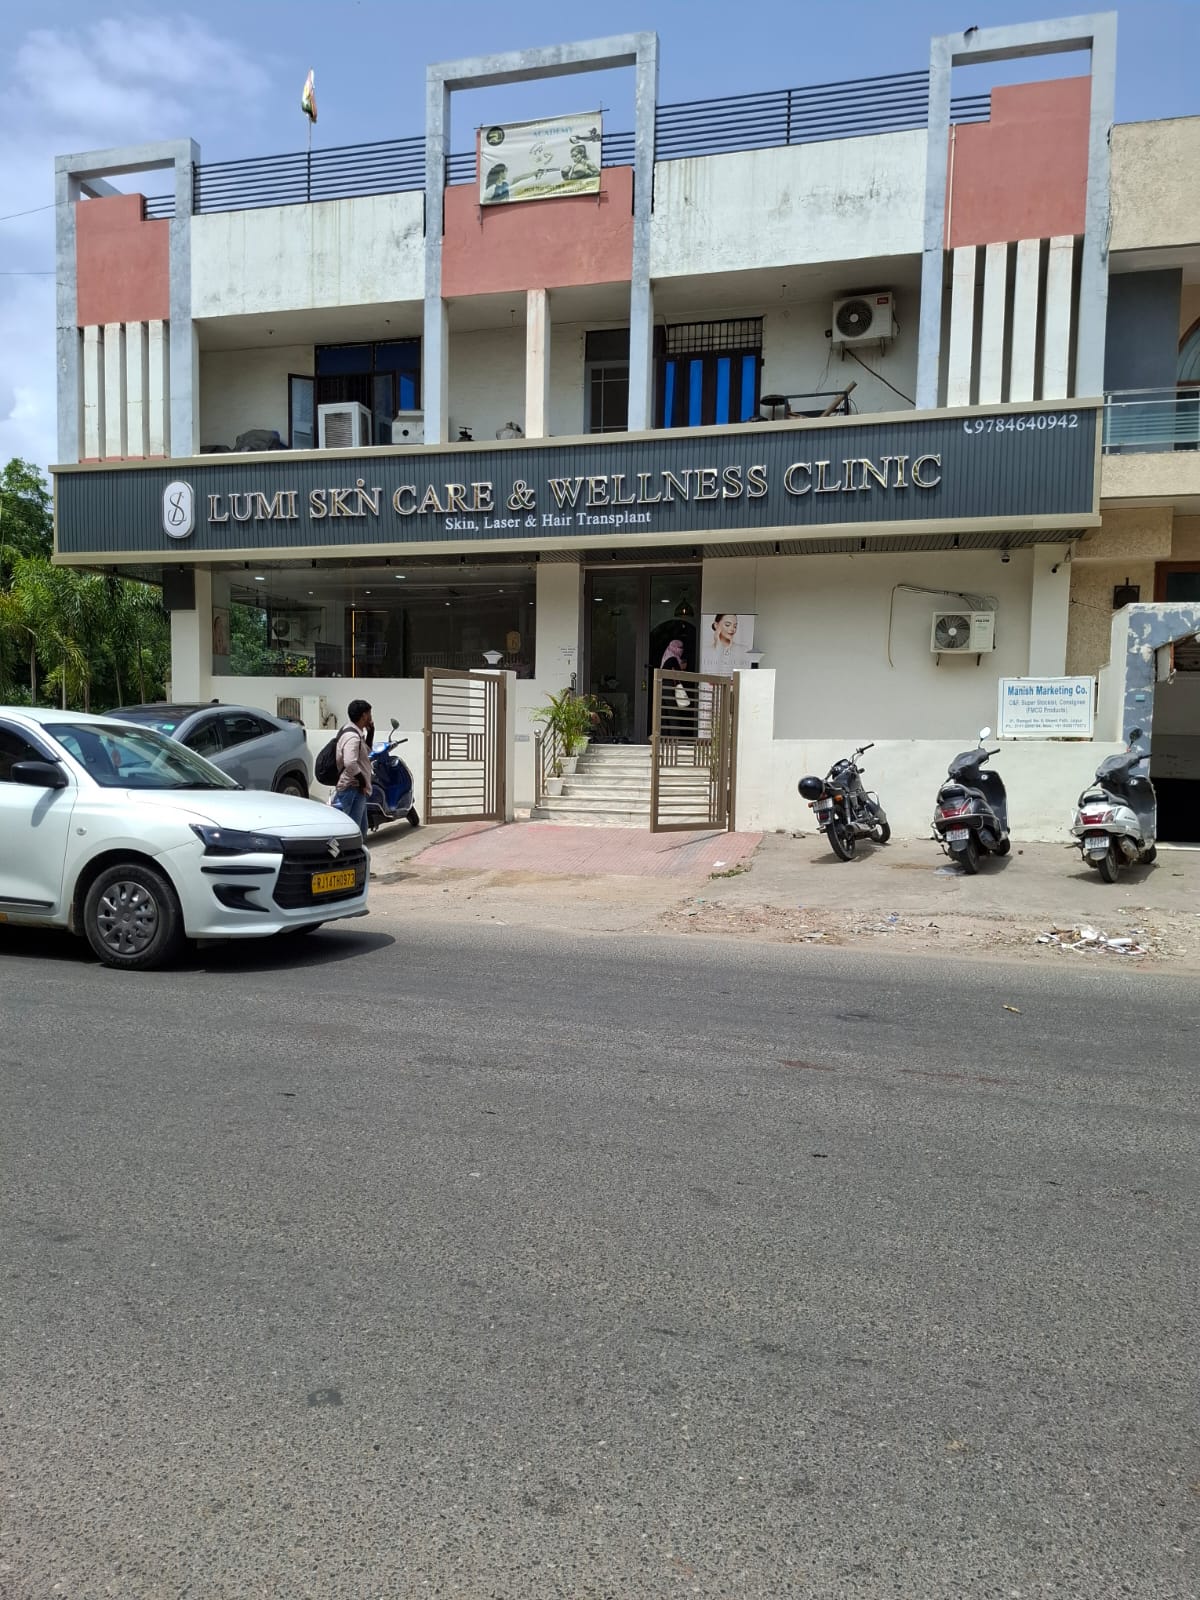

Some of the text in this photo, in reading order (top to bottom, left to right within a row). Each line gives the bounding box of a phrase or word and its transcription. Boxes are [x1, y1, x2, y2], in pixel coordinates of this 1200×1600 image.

[974, 413, 1079, 435] 9784640942
[207, 490, 299, 522] LUMI
[392, 481, 495, 516] CARE
[506, 479, 536, 511] &
[547, 463, 769, 510] WELLNESS
[783, 453, 943, 496] CLINIC
[445, 510, 652, 532] Skin, Laser & Hair Transplant
[1008, 685, 1088, 697] Manish Marketing Co.
